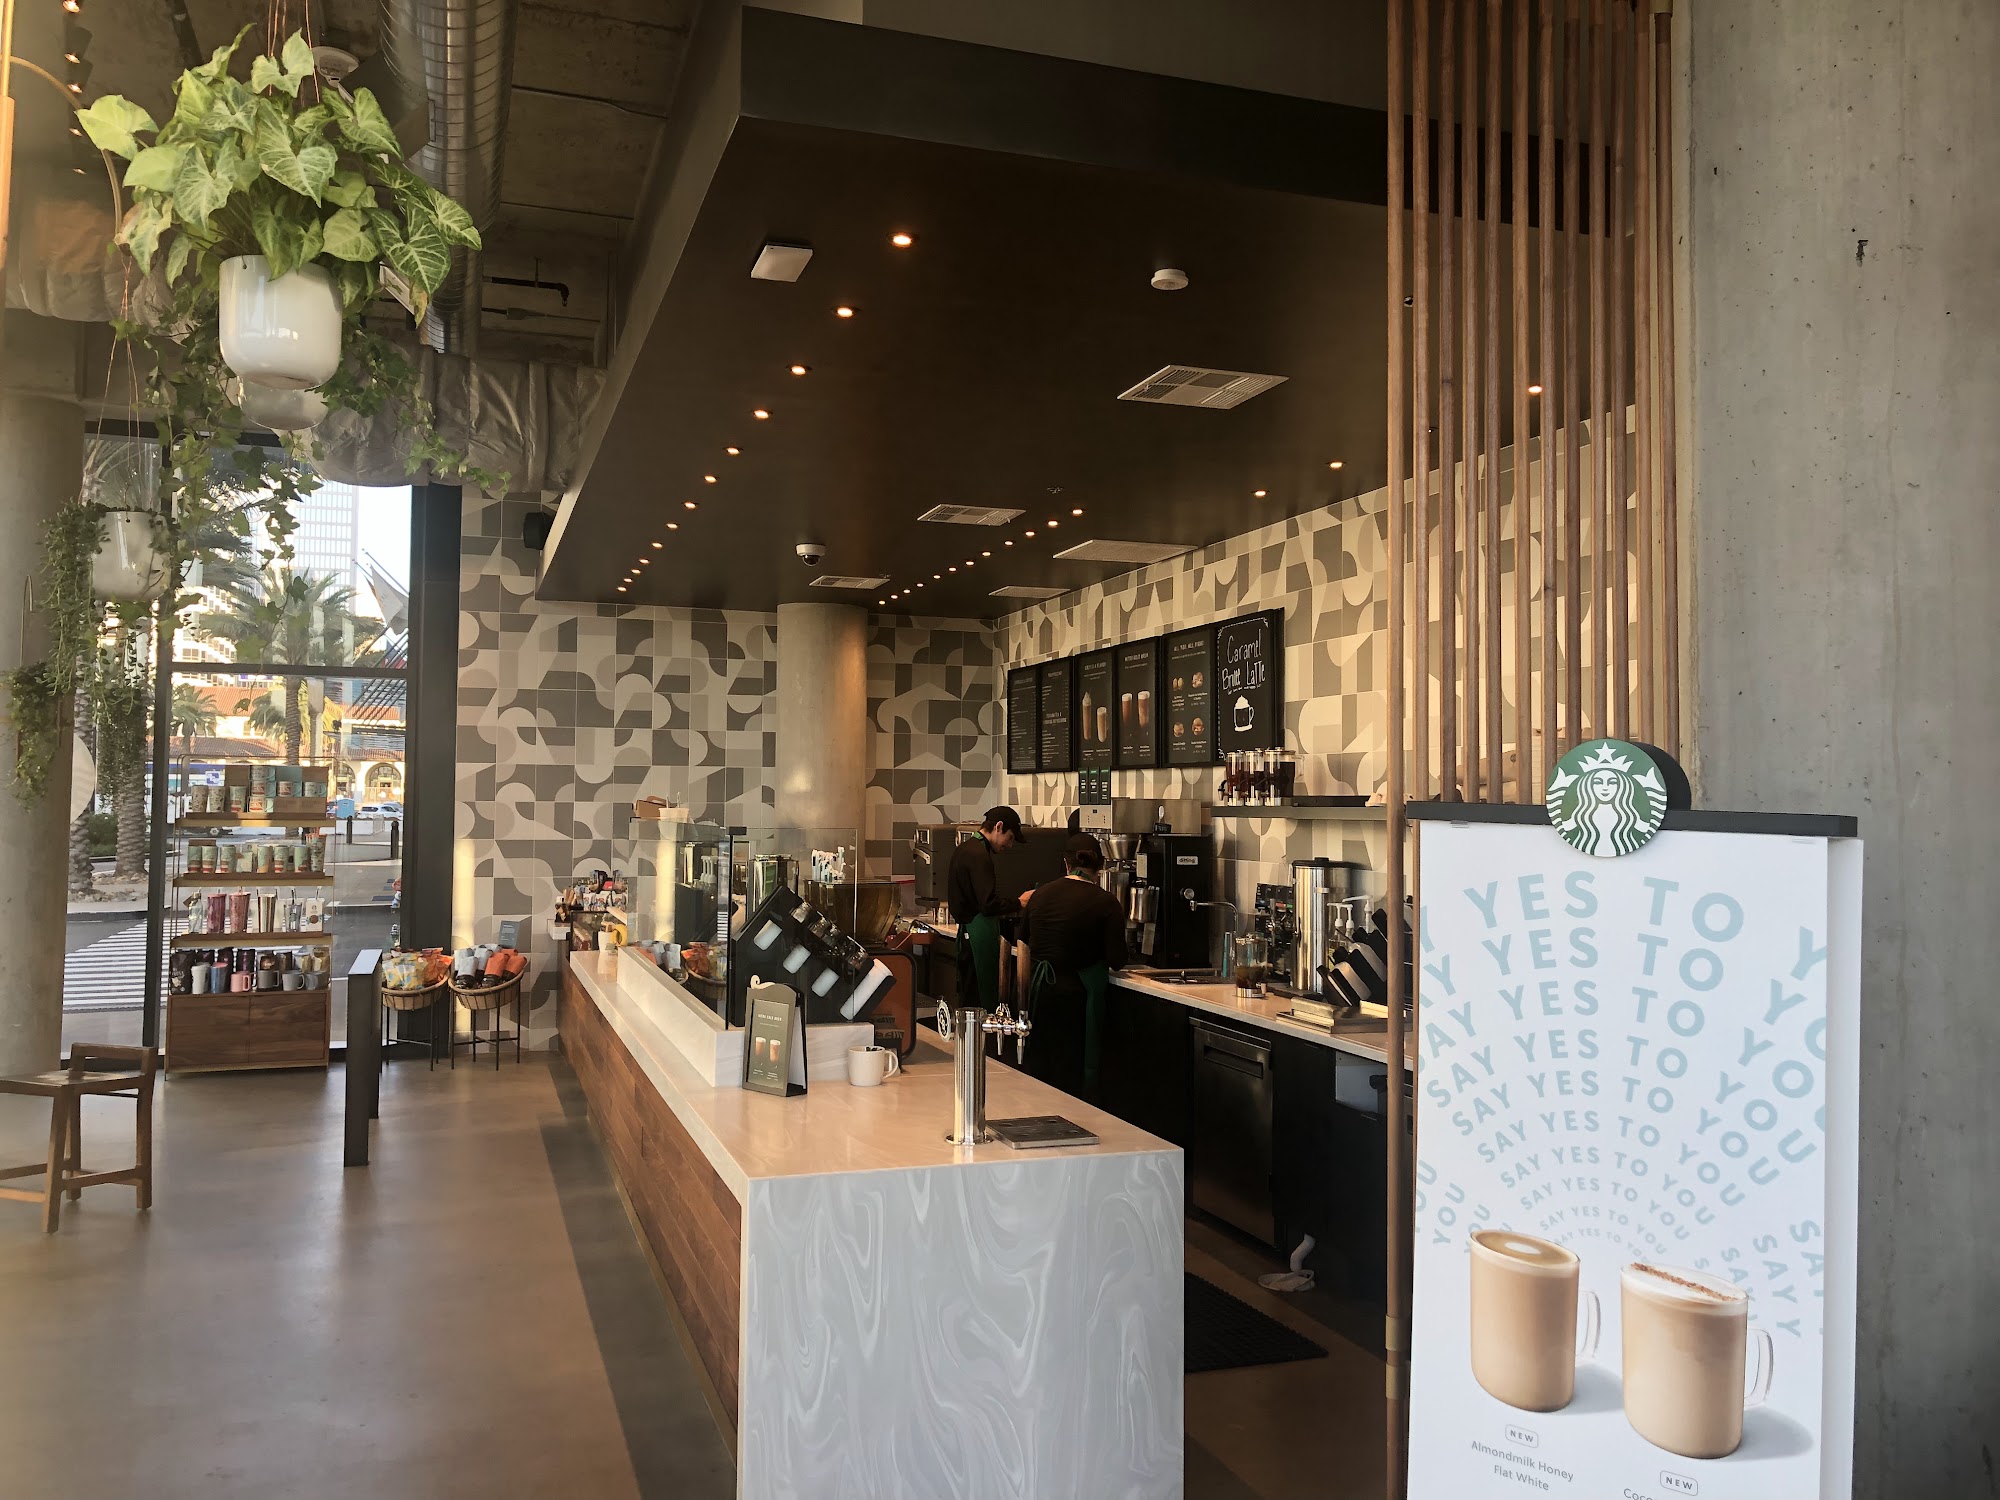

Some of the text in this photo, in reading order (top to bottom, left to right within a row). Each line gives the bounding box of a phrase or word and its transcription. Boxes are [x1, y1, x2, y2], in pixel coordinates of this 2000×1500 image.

[1227, 628, 1261, 664] Caramel
[1463, 870, 1598, 929] YES
[1643, 876, 1744, 942] TO
[1481, 926, 1599, 976] YES
[1637, 932, 1724, 991] TO
[1497, 979, 1599, 1021] YES
[1631, 986, 1705, 1037] TO
[1426, 1028, 1818, 1163] SAY YES TO YOU
[1452, 1069, 1780, 1185] SAY YES TO YOU
[1477, 1110, 1745, 1206] SAY YES TO YOU
[1500, 1146, 1716, 1225] SAY YES TO YOU
[1433, 1183, 1465, 1245] YOU
[1520, 1176, 1691, 1240] SAY YES TO YOU
[1539, 1205, 1667, 1255] SAY YES TO YOU
[1752, 1234, 1798, 1304] SAY
[1471, 1440, 1574, 1482] Almondmilk Honey
[1509, 1430, 1534, 1443] NEW
[1494, 1464, 1549, 1491] Flat White
[1665, 1476, 1692, 1490] NEW
